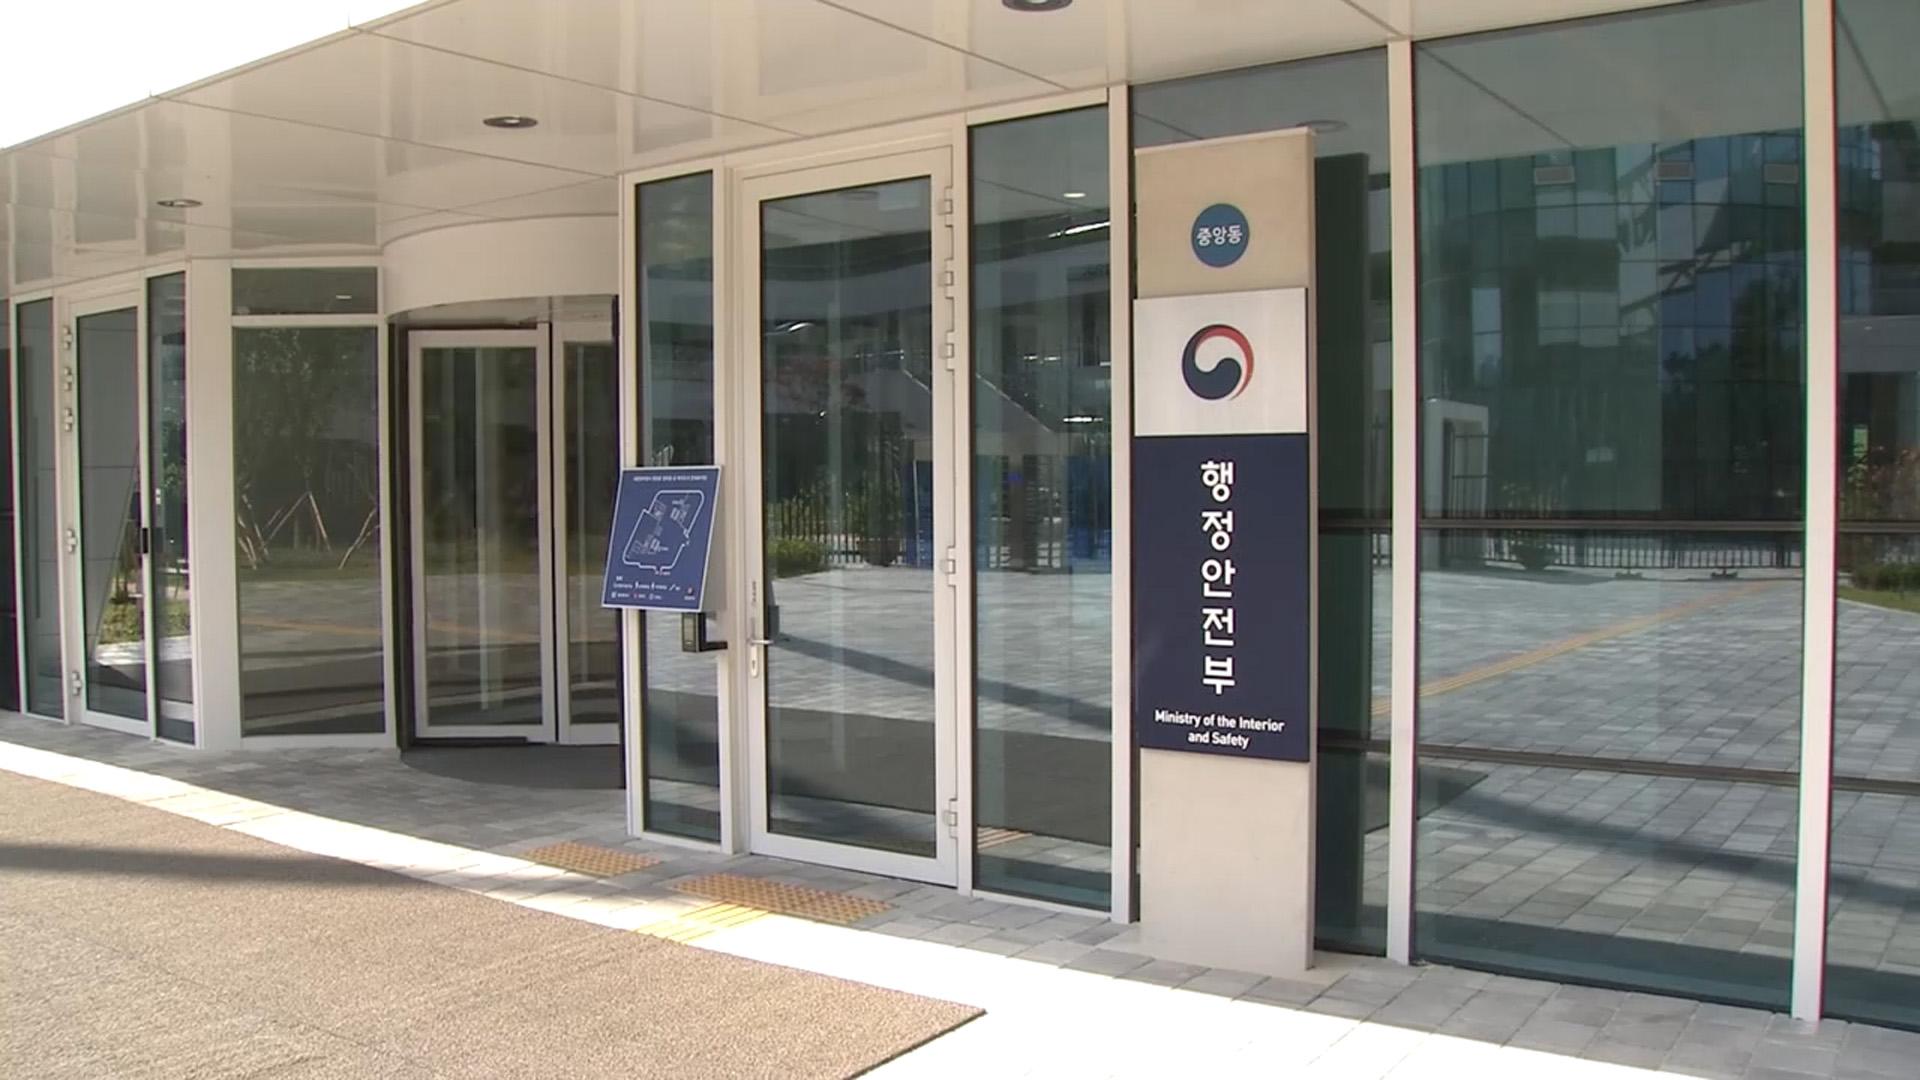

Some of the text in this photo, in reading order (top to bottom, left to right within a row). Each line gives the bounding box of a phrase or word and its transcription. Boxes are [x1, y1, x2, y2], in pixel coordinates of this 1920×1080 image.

[1197, 224, 1242, 246] 중앙동
[1200, 460, 1236, 695] 행정안전부
[1155, 710, 1285, 731] Ministry of the Interior
[1188, 731, 1249, 749] and Safety
